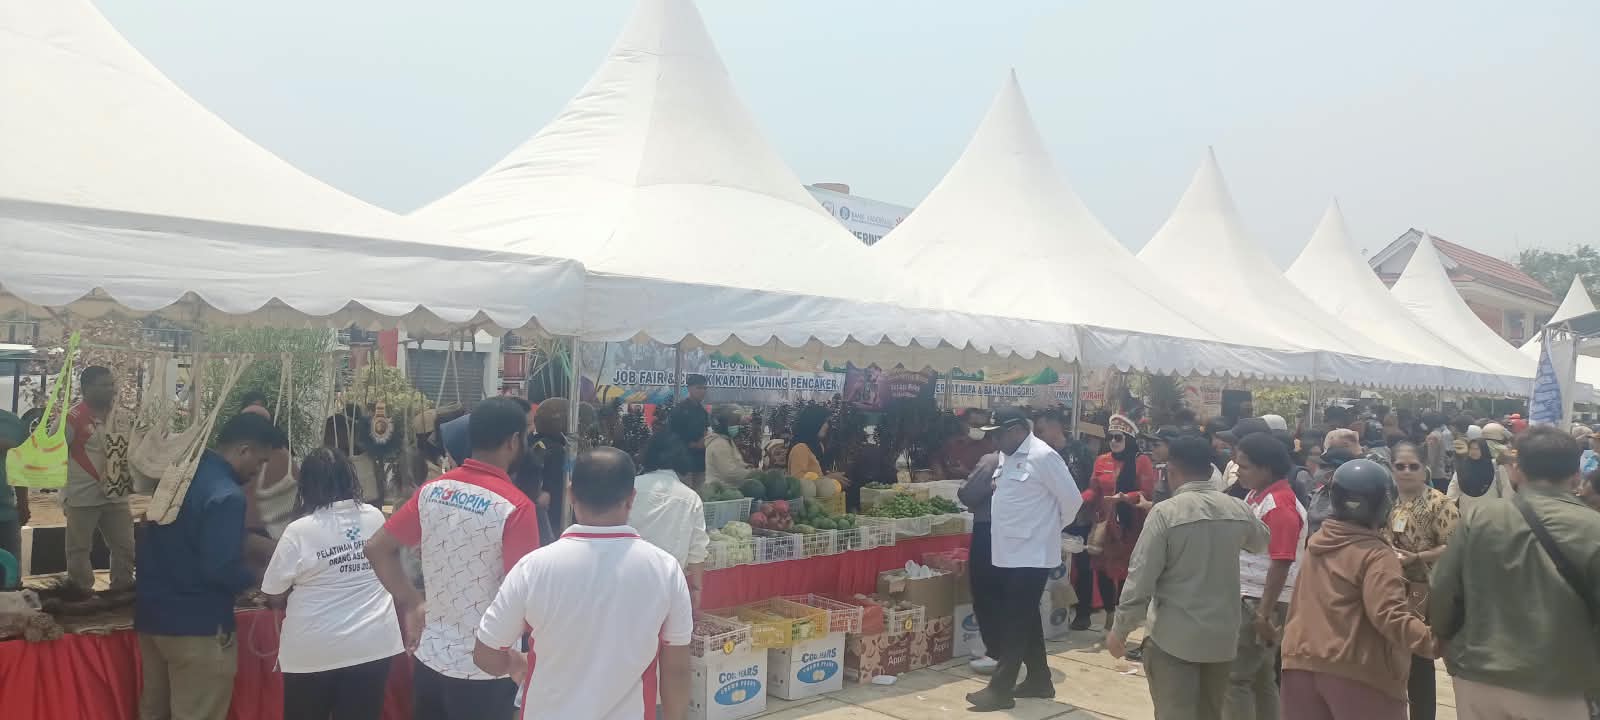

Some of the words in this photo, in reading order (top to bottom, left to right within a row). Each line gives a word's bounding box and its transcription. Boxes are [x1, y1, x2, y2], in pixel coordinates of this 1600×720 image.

[613, 370, 636, 385] JOB
[639, 370, 665, 385] FAIR
[667, 372, 675, 385] &
[715, 374, 749, 387] KARTU
[751, 376, 788, 389] KUNING
[790, 377, 837, 390] PENCAKER
[430, 486, 492, 512] PROKOPIM
[316, 543, 352, 560] PELATIHAN
[329, 553, 352, 566] ORANG
[339, 563, 361, 573] OTSUS
